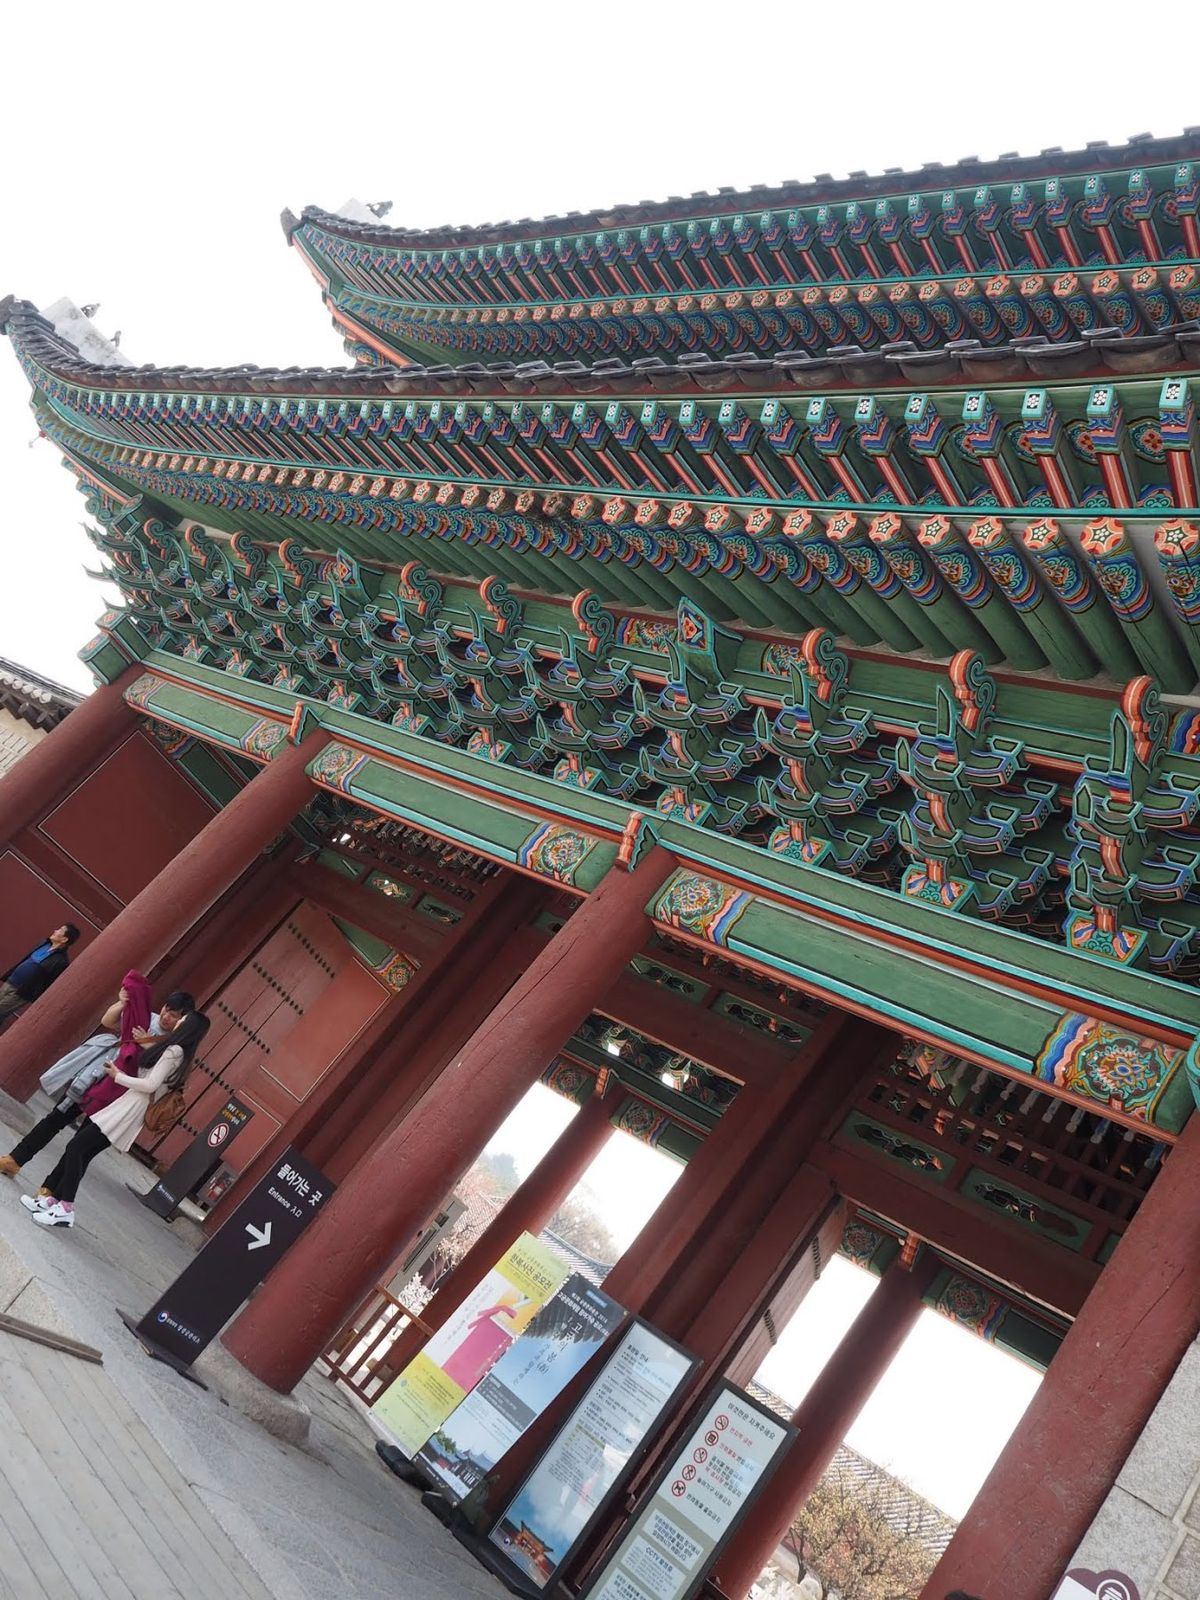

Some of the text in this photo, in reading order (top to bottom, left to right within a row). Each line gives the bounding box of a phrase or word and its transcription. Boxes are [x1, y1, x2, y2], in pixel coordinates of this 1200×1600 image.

[275, 1162, 323, 1206] 들어가는 곳
[267, 1186, 303, 1217] Entrance 入口
[531, 1270, 553, 1290] 공모전
[726, 1402, 776, 1440] 이것만은 지켜주세요
[644, 1545, 659, 1560] CCTV
